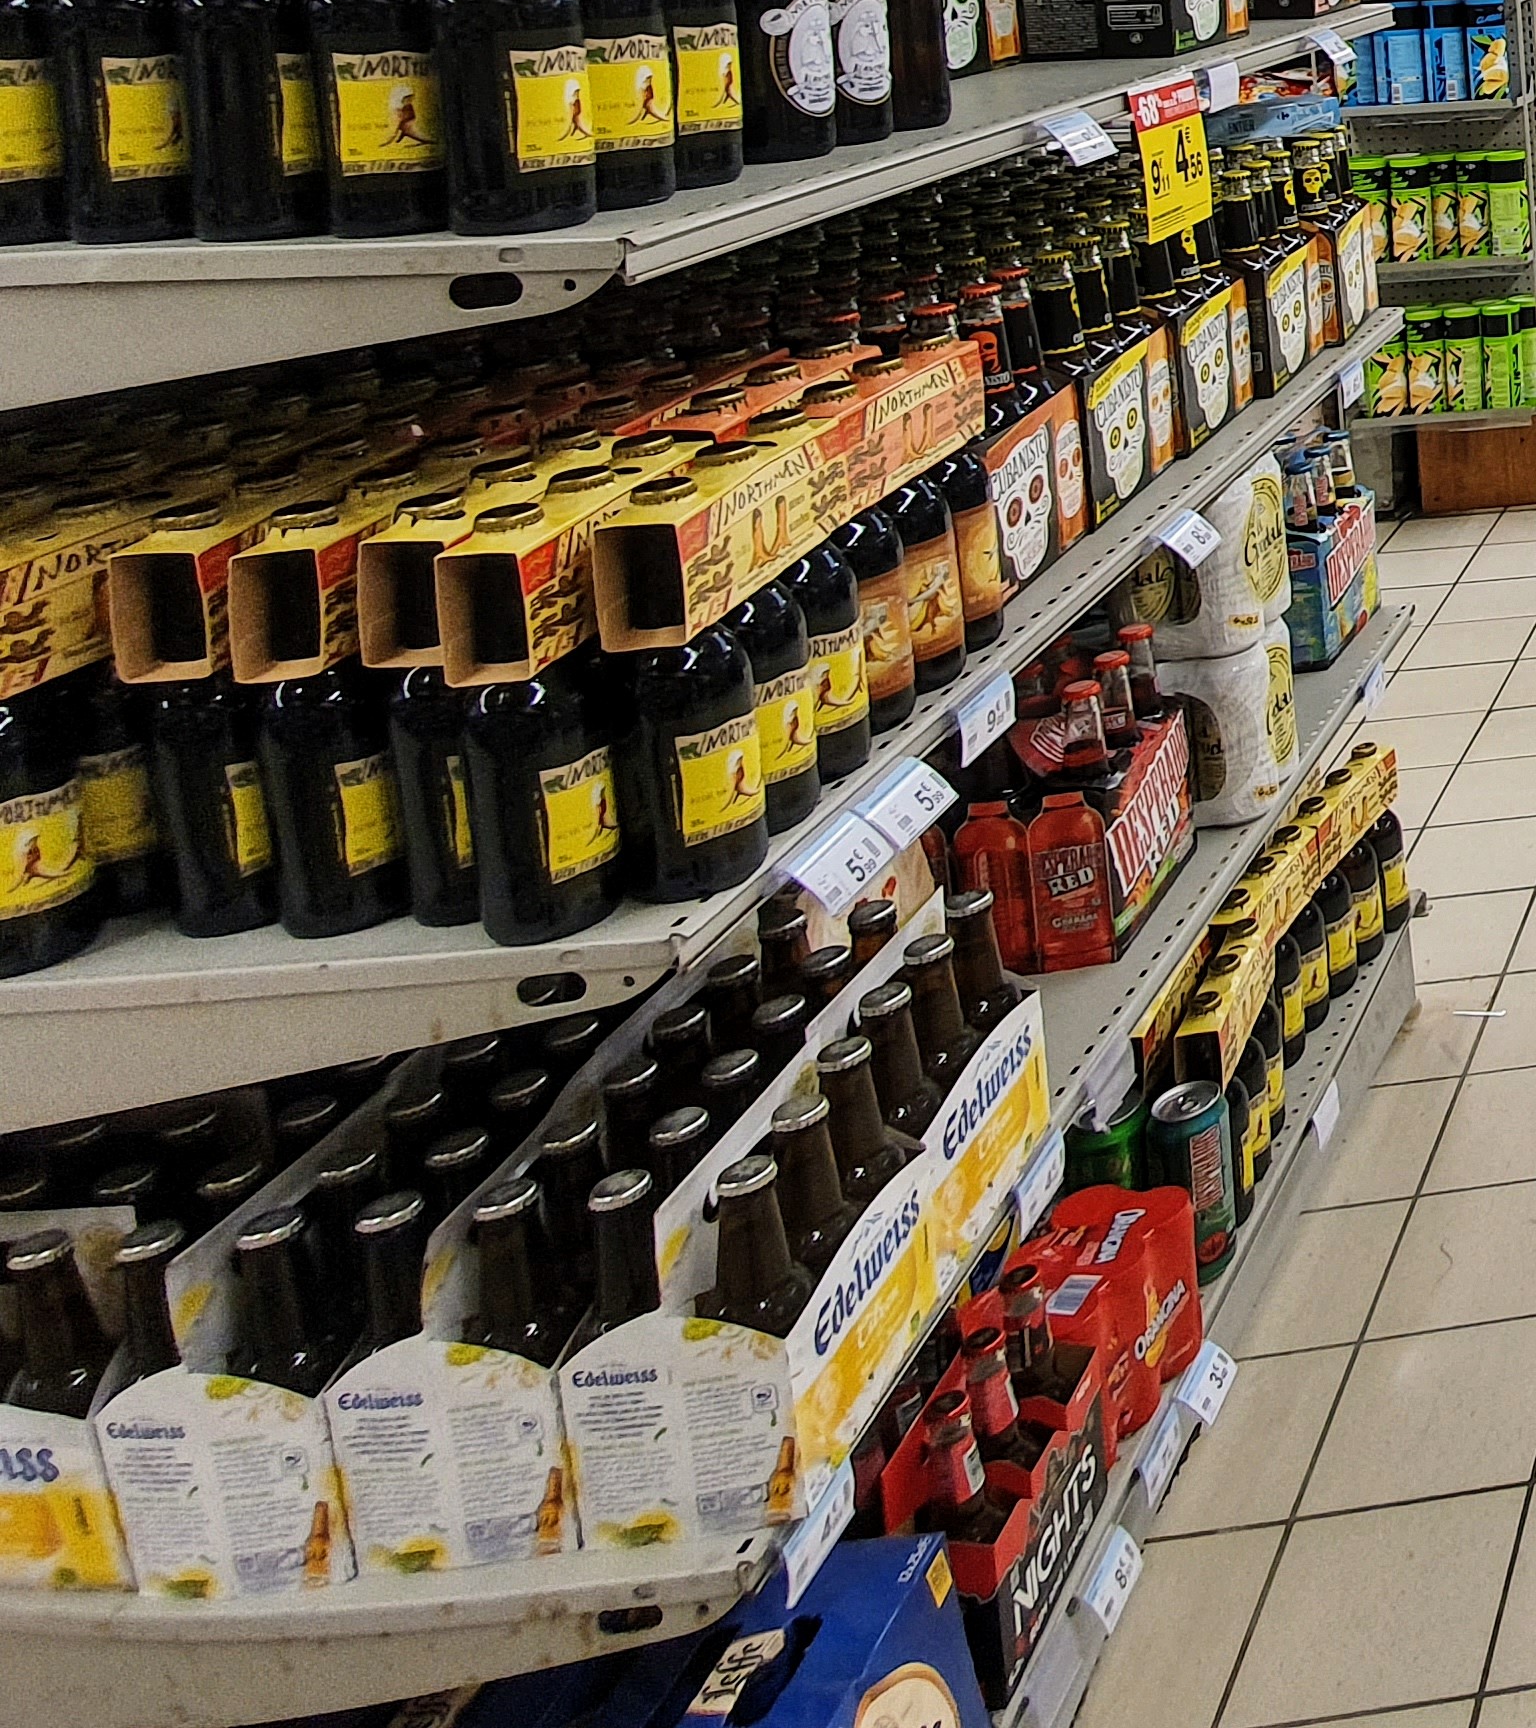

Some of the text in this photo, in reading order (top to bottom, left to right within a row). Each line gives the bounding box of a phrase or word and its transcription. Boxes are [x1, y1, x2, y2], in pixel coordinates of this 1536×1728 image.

[991, 422, 1050, 501] CUBANISTO
[1048, 867, 1095, 896] RED
[941, 1025, 1032, 1162] Edelweiss
[814, 1189, 921, 1358] Edelweiss
[1134, 1278, 1188, 1361] ORANGINA
[337, 1390, 425, 1411] Edelweiss
[572, 1368, 659, 1389] Edelweiss
[106, 1421, 187, 1441] Edelweiss
[701, 1642, 763, 1704] Leffe
